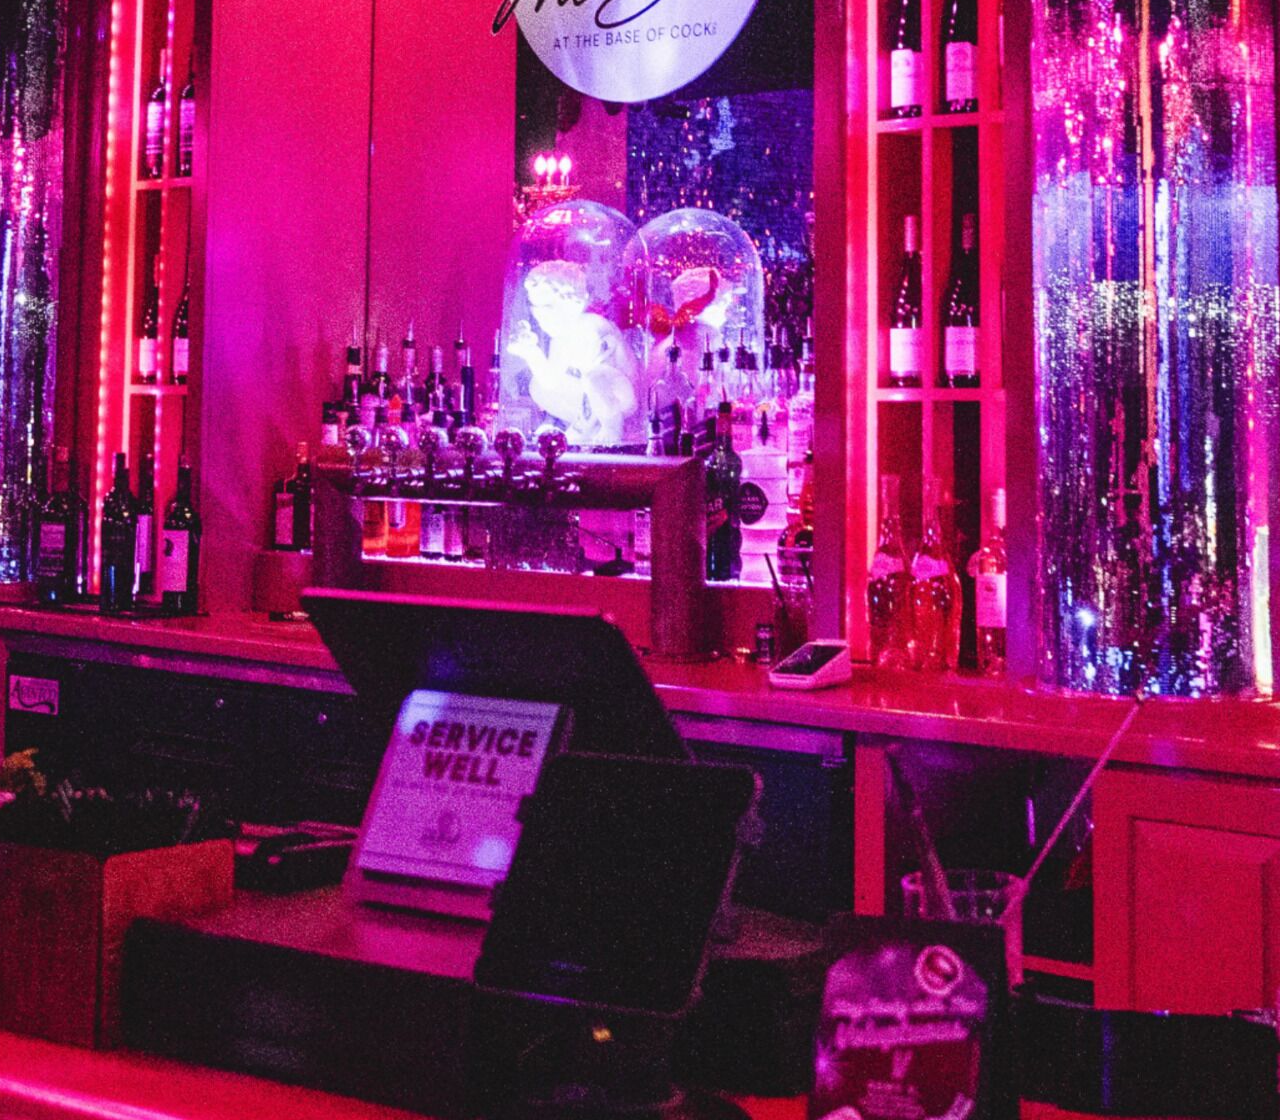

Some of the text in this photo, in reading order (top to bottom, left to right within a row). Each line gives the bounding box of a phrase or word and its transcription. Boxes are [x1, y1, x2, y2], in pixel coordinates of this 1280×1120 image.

[553, 36, 569, 50] AT
[575, 34, 600, 48] THE
[605, 31, 640, 46] BASE
[646, 27, 665, 42] OF
[410, 720, 538, 758] SERVICE
[423, 751, 502, 786] WELL
